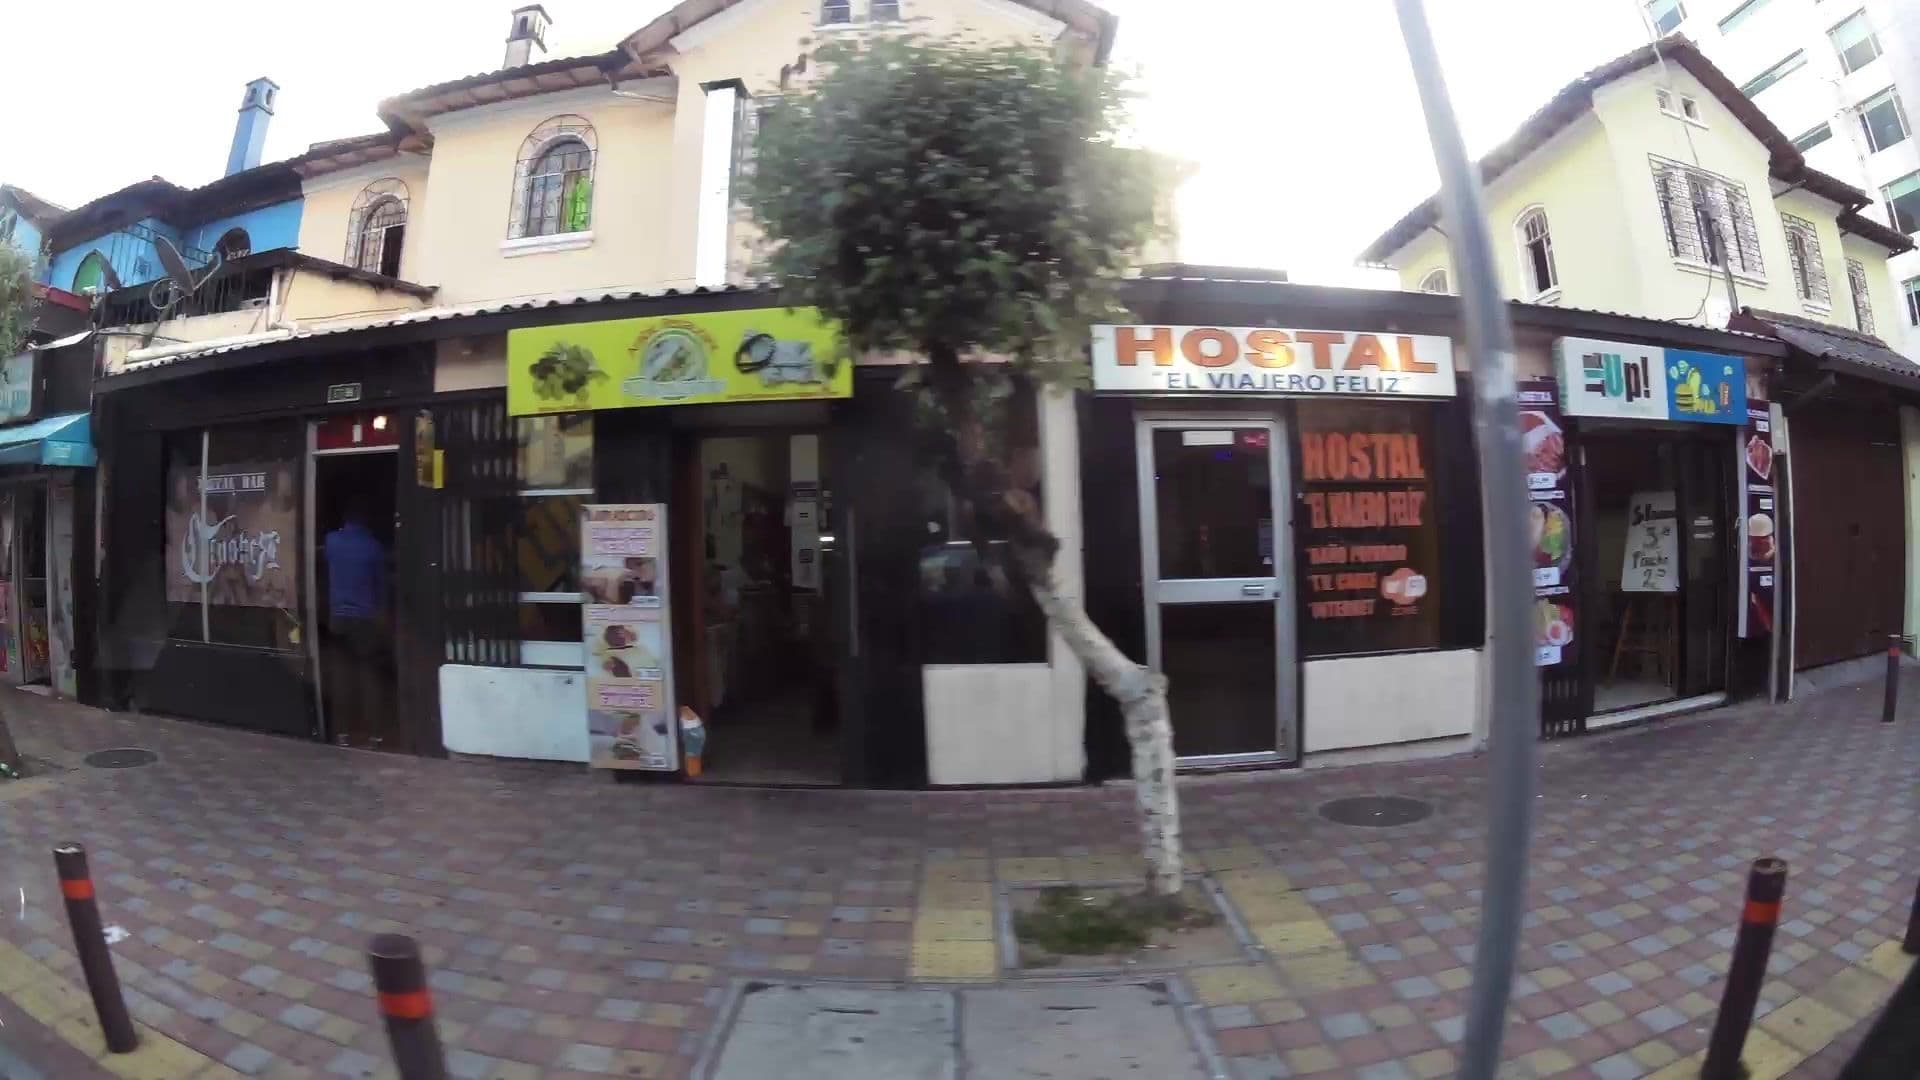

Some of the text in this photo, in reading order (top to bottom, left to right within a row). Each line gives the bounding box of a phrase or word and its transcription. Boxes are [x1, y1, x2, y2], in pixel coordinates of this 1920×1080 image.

[1114, 327, 1437, 374] HOSTAL
[1208, 372, 1326, 391] VIAJERO
[1302, 432, 1426, 480] HOSTAL
